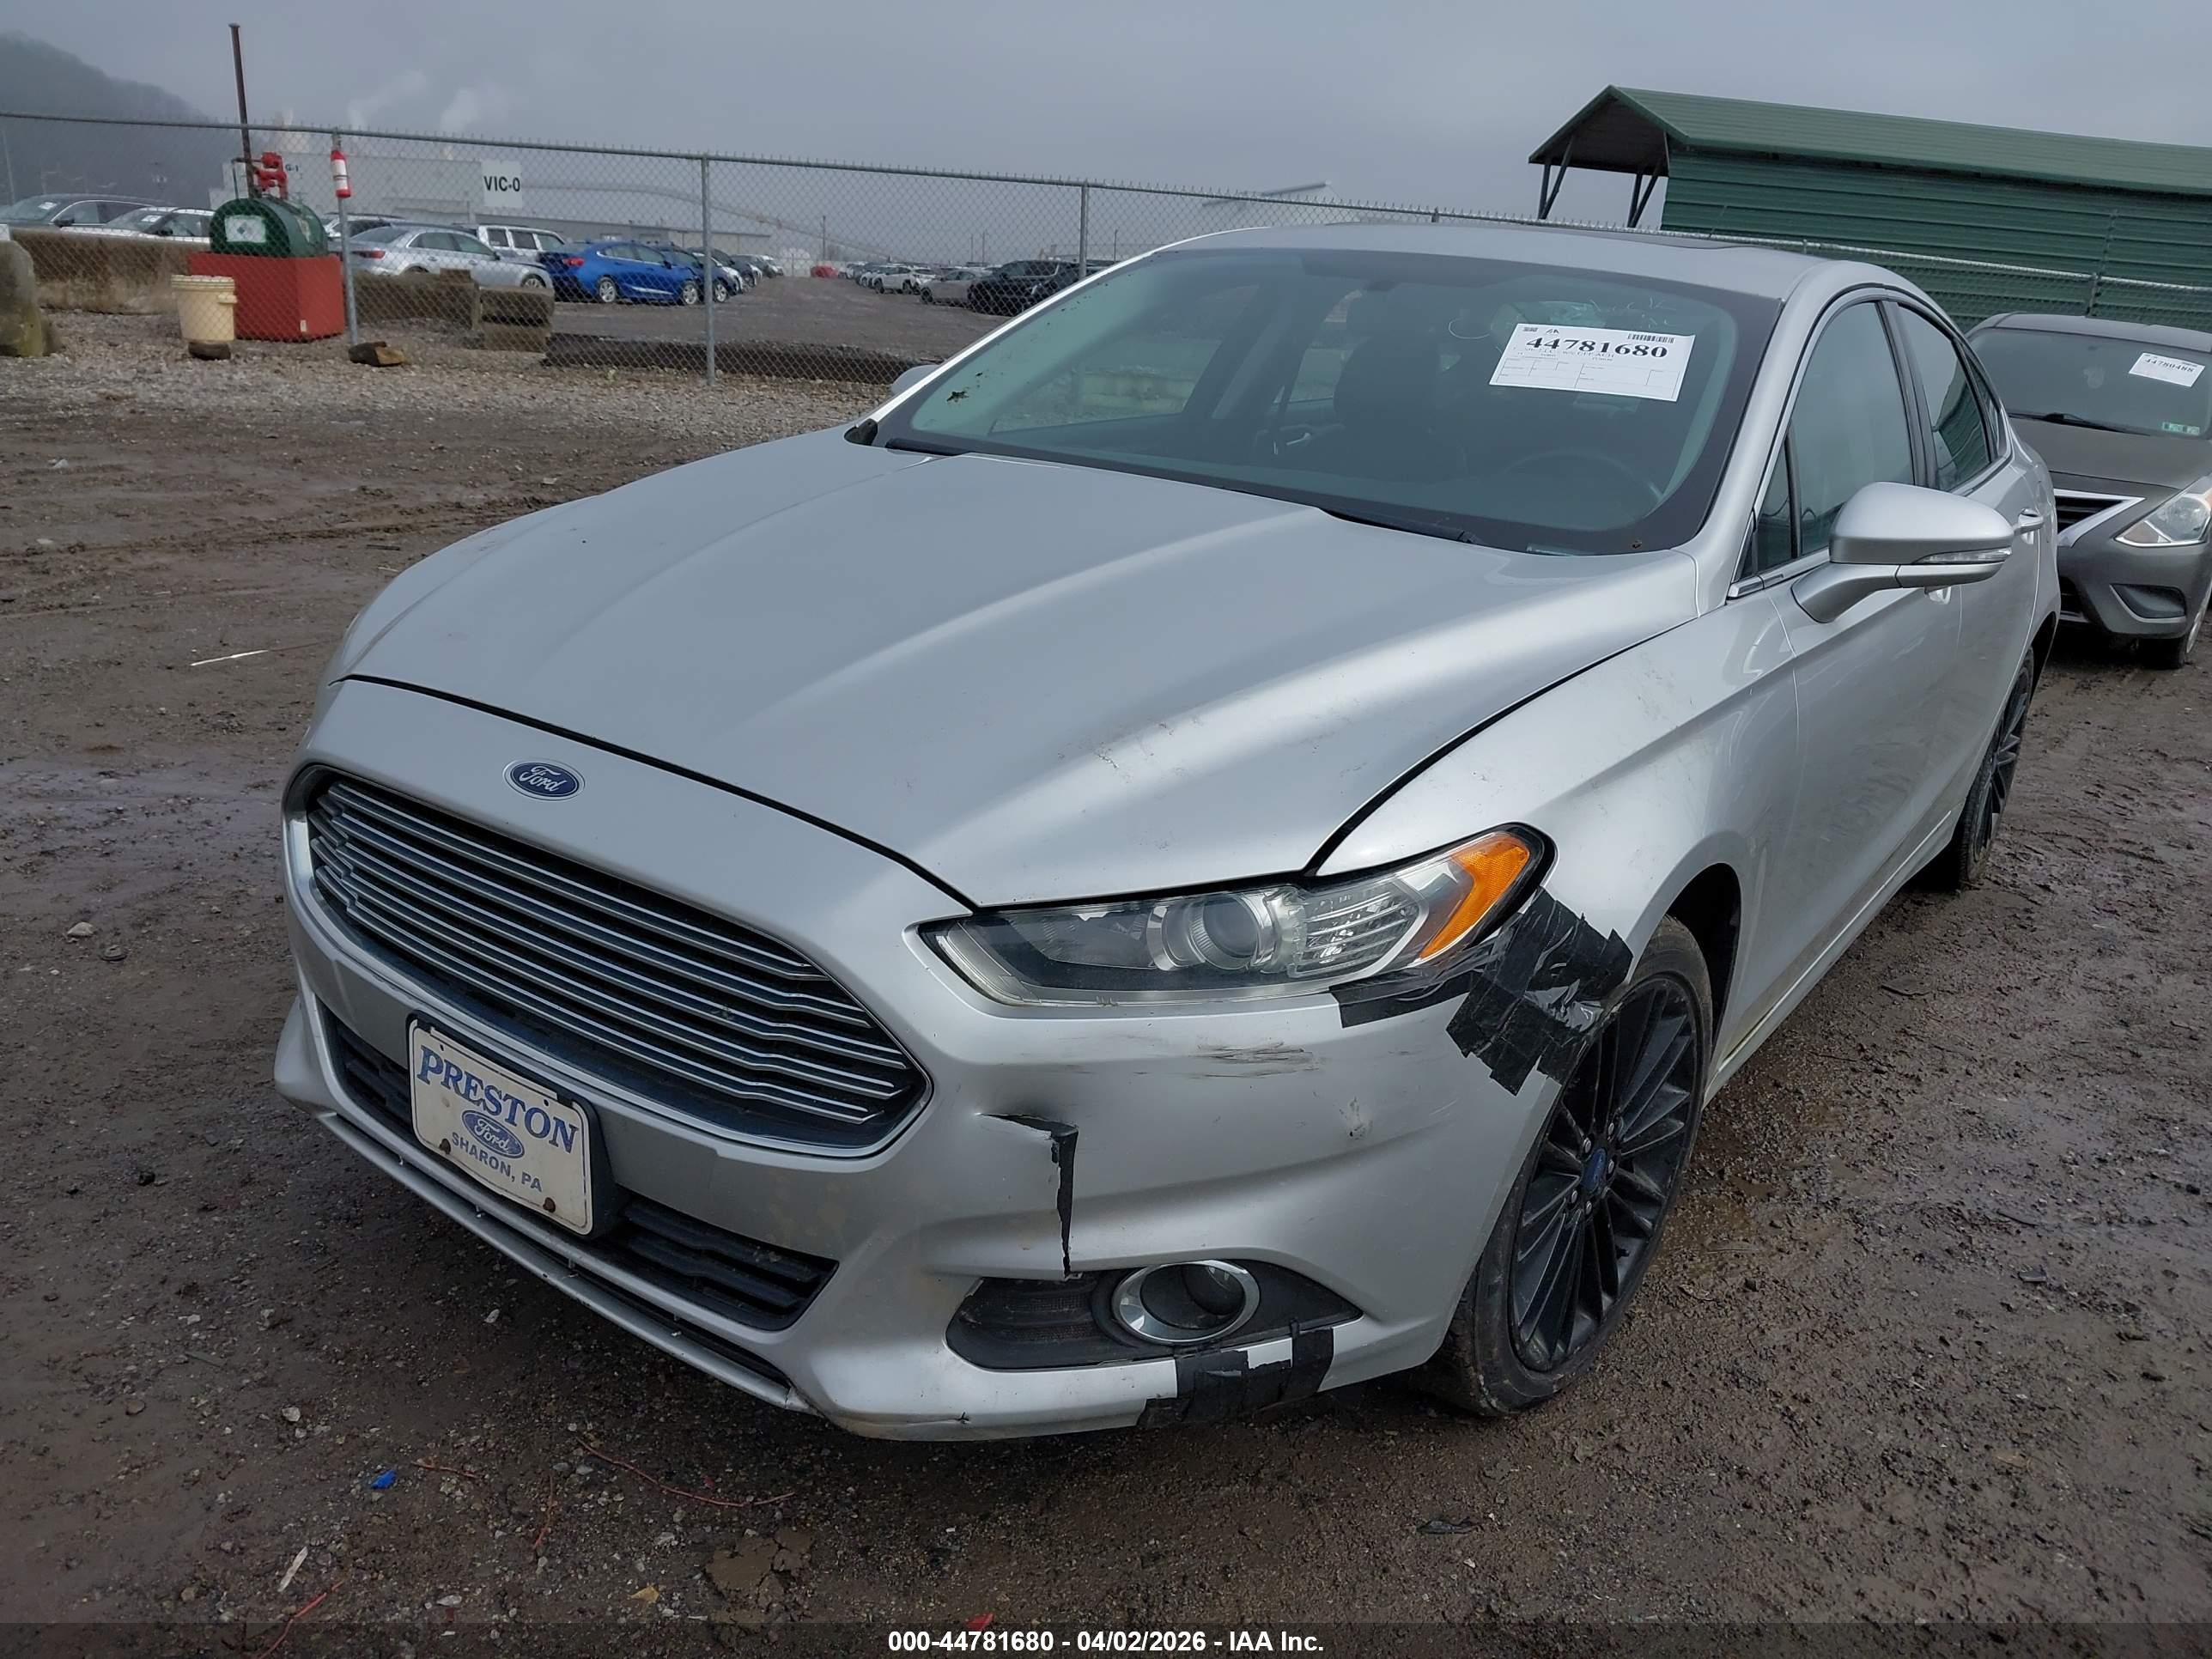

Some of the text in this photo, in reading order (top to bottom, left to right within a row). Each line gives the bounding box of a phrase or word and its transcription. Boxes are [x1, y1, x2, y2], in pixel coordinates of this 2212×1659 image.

[1526, 337, 1668, 358] 44781680
[519, 766, 567, 792] Ford
[416, 1044, 579, 1153] PRESTON
[474, 1118, 510, 1153] Ford
[452, 1132, 543, 1193] SHARON, PA
